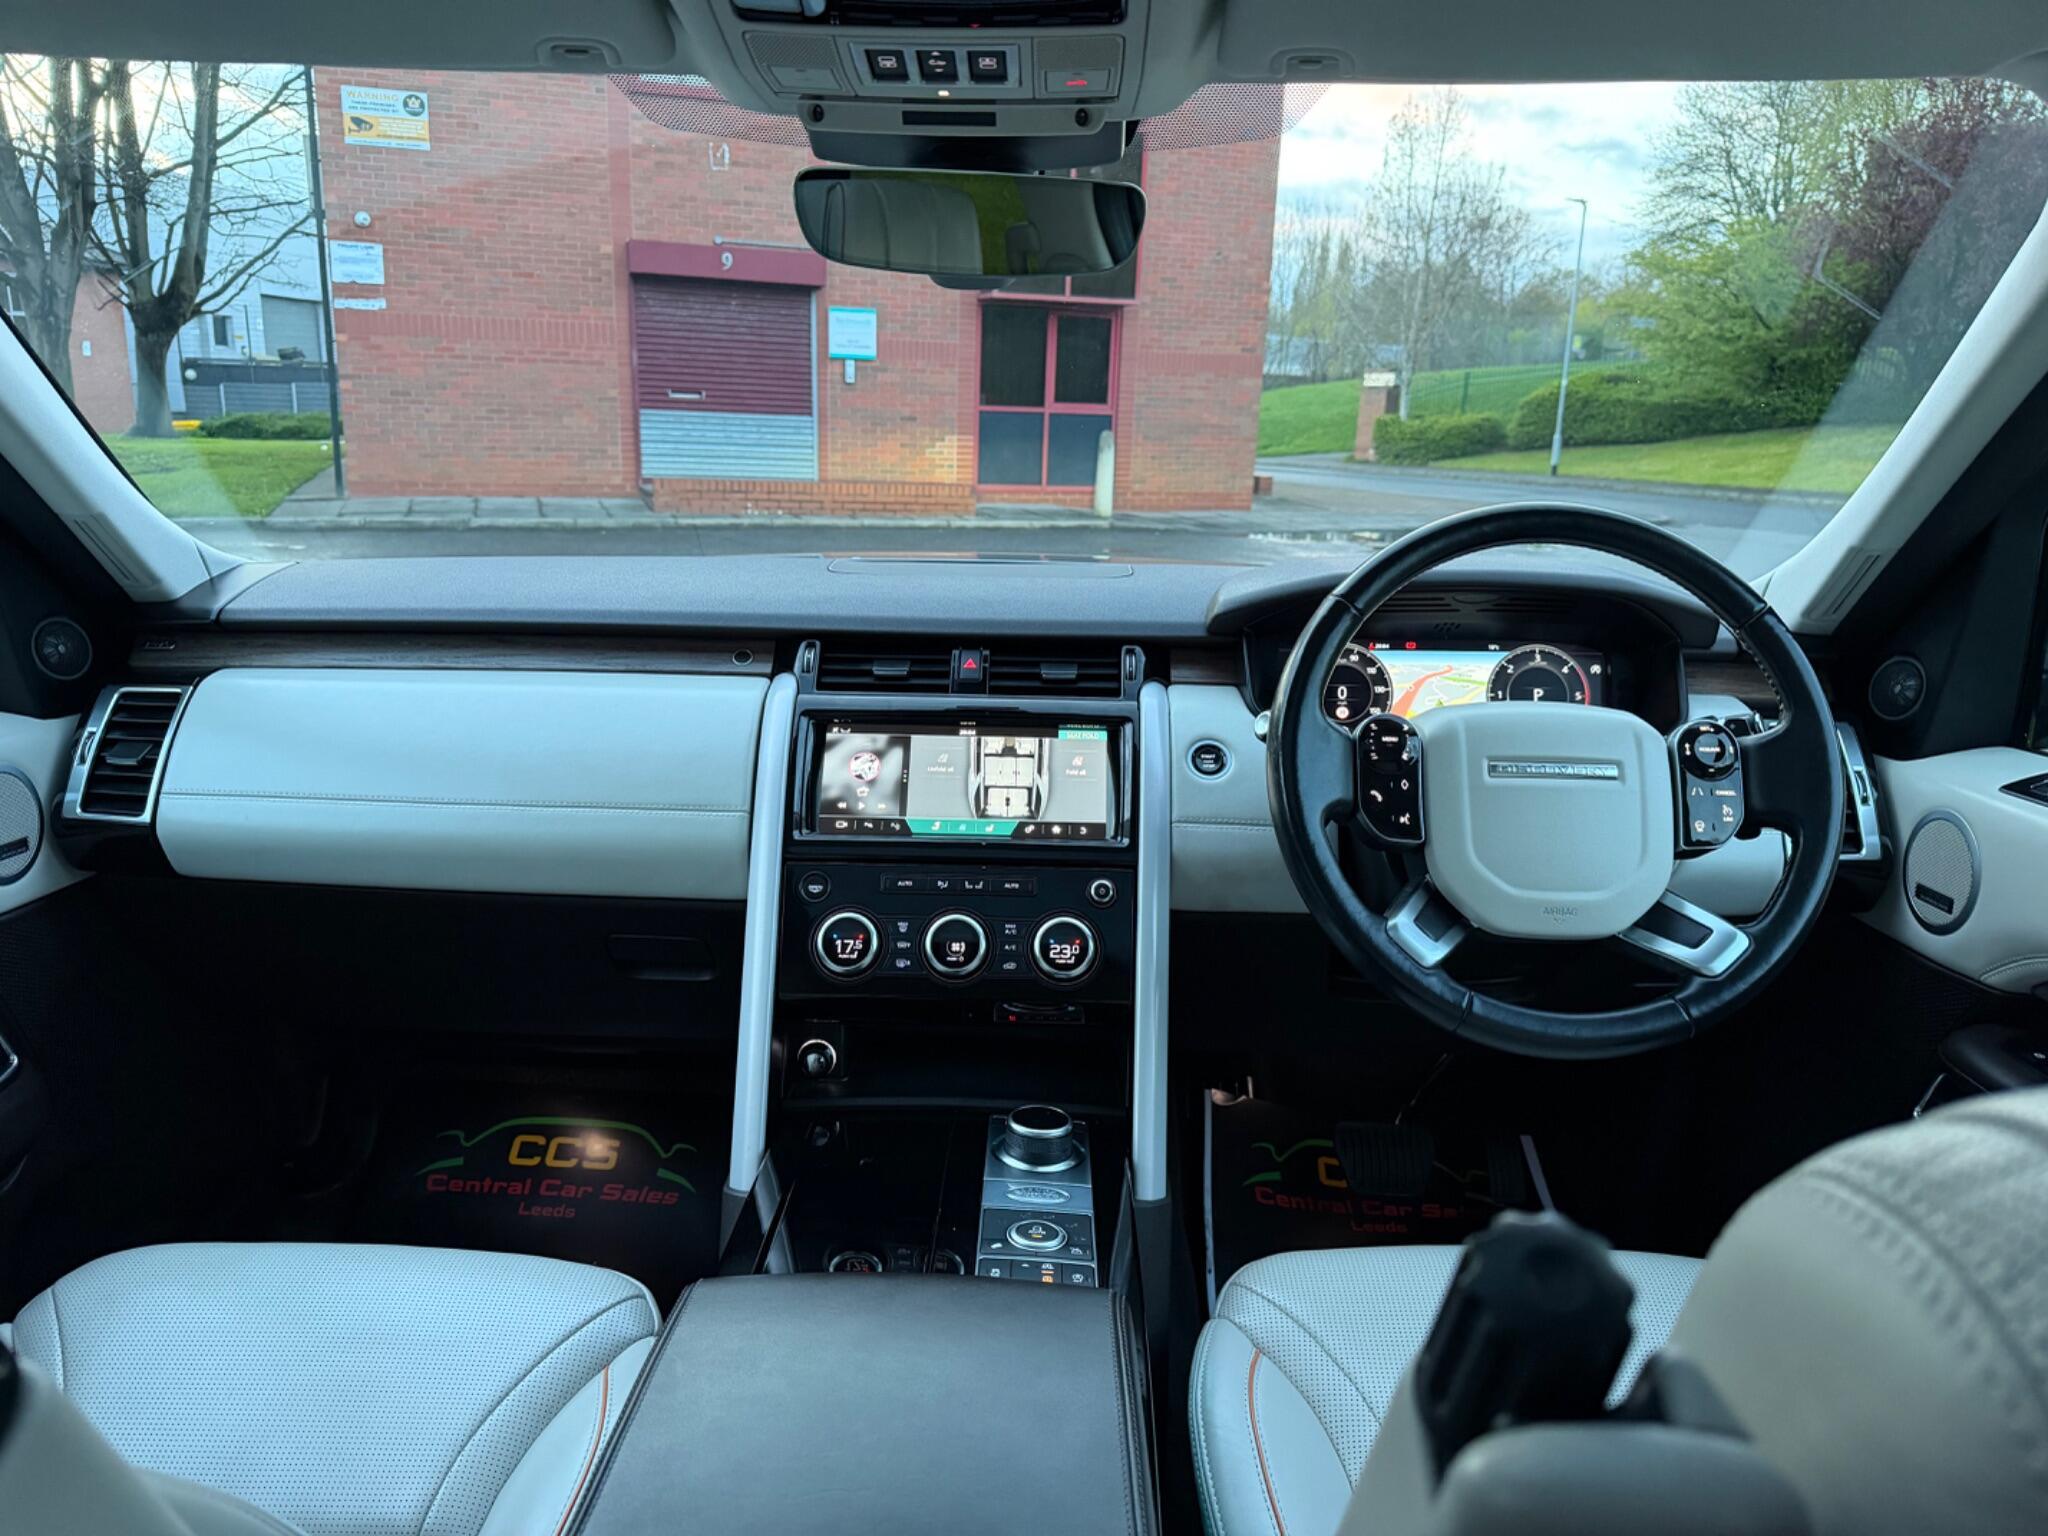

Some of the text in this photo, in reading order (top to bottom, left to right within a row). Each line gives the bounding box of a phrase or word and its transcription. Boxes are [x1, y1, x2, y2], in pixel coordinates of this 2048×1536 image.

[721, 252, 733, 270] 9
[1507, 665, 1514, 674] 2
[1561, 666, 1569, 674] 4
[1337, 686, 1348, 700] 0
[1533, 688, 1544, 702] P
[1575, 691, 1582, 700] 5
[1497, 763, 1612, 777] DISCOVERY
[1542, 907, 1578, 917] AIRBAG
[835, 939, 863, 954] 17.5
[1050, 944, 1080, 959] 23.0
[508, 1133, 621, 1171] CCS
[425, 1172, 680, 1206] Central Car Sales
[1254, 1184, 1353, 1215] Central
[1361, 1199, 1414, 1217] Car
[518, 1201, 576, 1218] Leeds
[1351, 1219, 1409, 1234] Leeds
